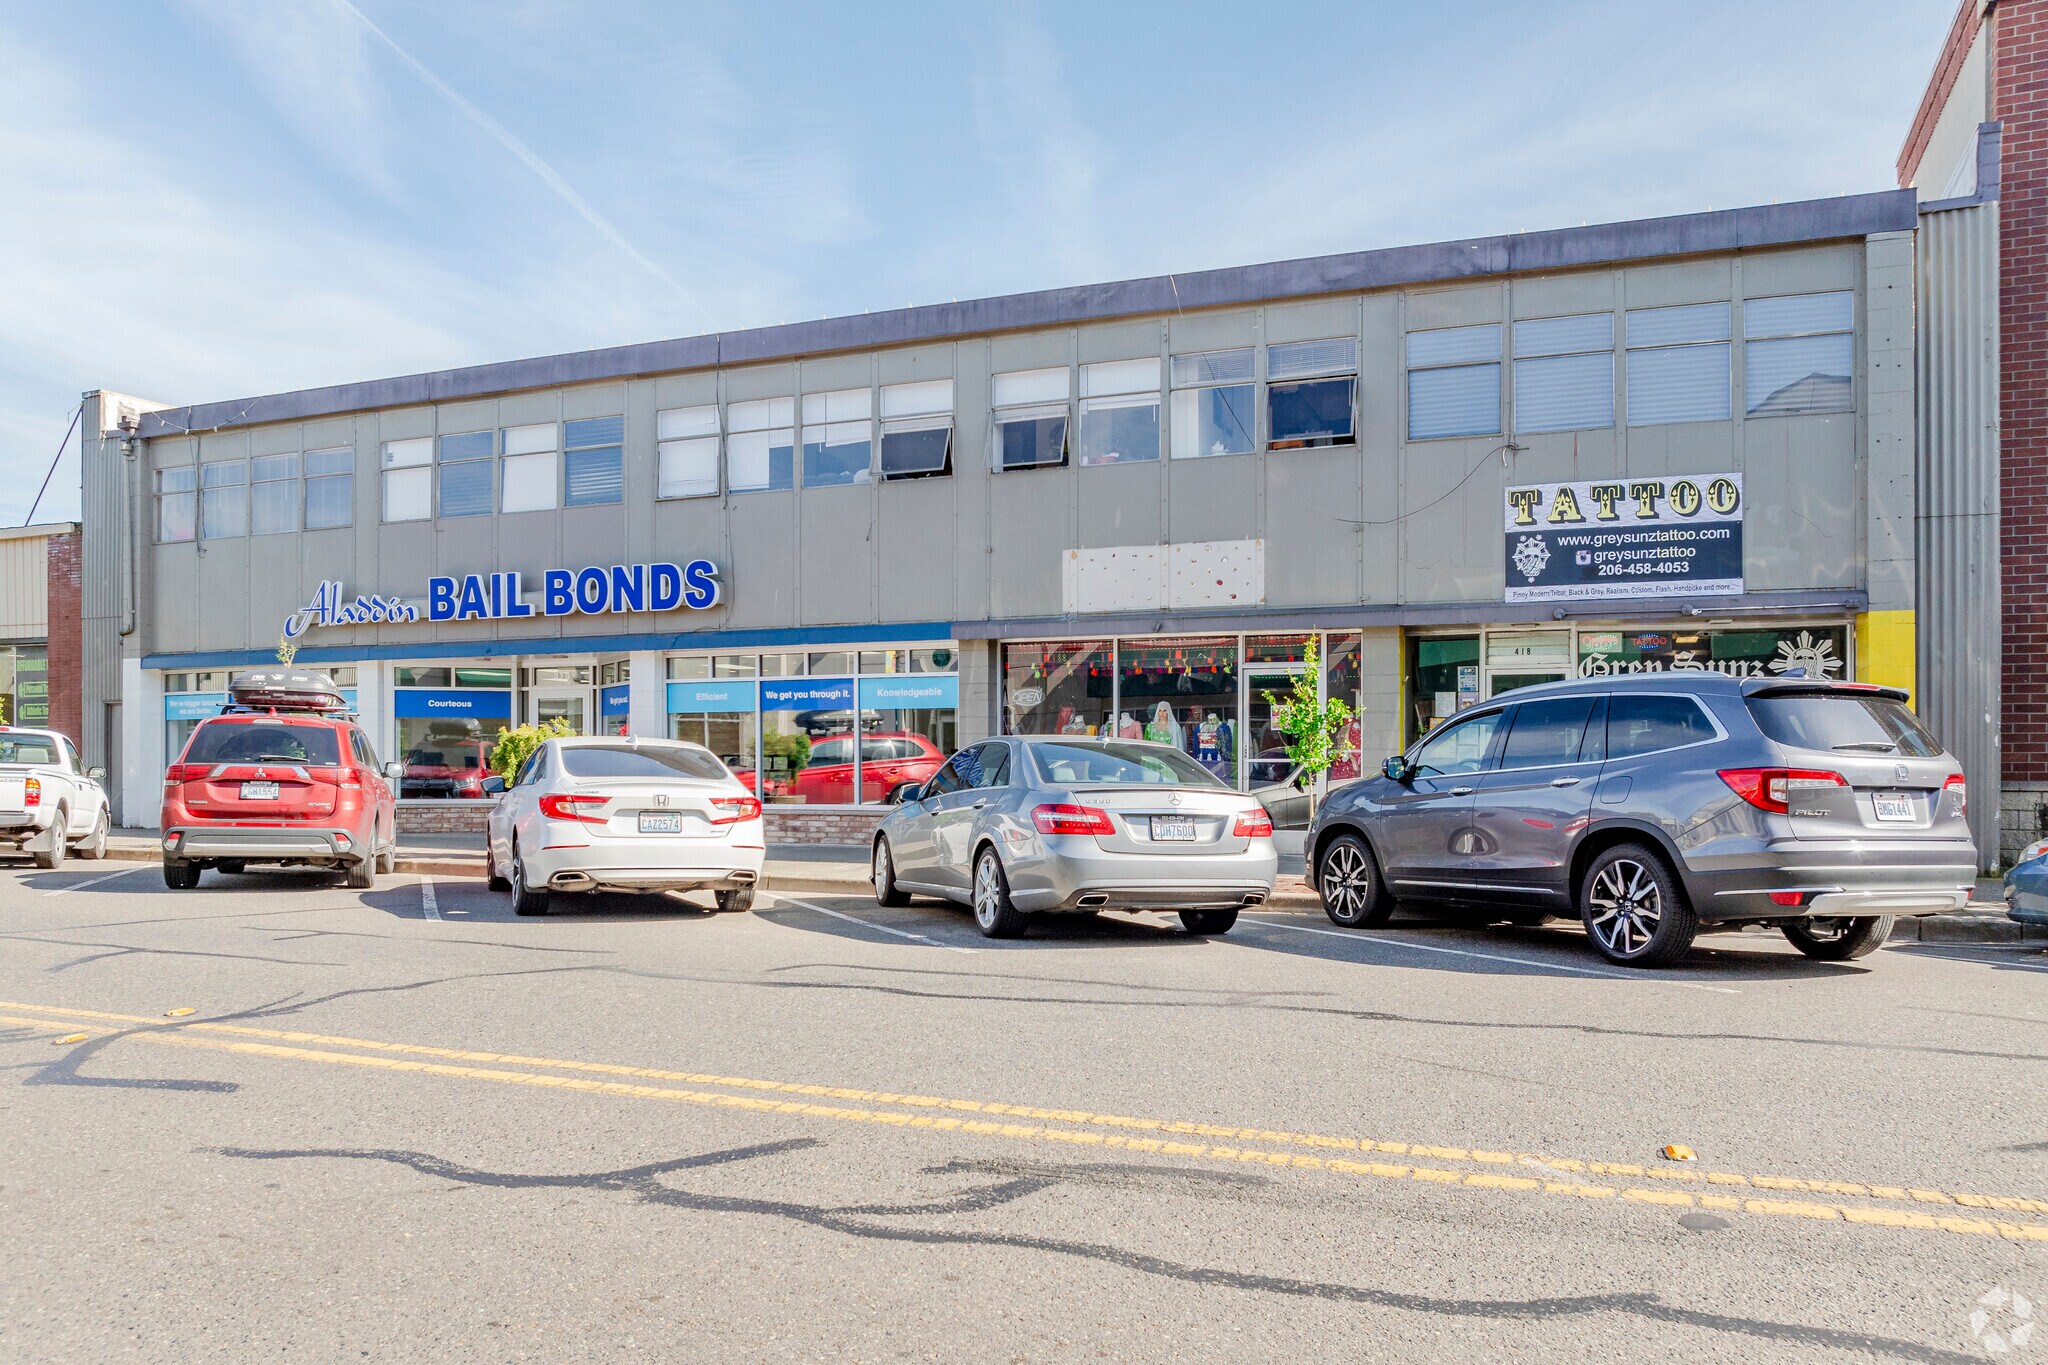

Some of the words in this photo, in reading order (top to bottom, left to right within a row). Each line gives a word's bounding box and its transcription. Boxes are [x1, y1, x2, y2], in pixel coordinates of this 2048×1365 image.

[1508, 477, 1740, 526] TATTOO
[1558, 527, 1730, 547] www.greysunztattoo.com
[1594, 546, 1696, 564] greysunztattoo
[1598, 561, 1690, 577] 206-458-4053
[284, 580, 419, 638] Aladdin
[428, 572, 536, 622] BAIL
[544, 559, 720, 617] BONDS
[1513, 591, 1529, 599] Pinoy
[1568, 588, 1584, 596] Black
[1631, 637, 1667, 647] TATTOO
[1514, 647, 1531, 655] 418
[696, 693, 728, 701] Efficient
[765, 691, 778, 699] We
[779, 692, 792, 701] get
[793, 692, 808, 701] you
[810, 690, 841, 700] through
[842, 690, 851, 698] it.
[877, 688, 942, 699] Knowledgeable
[1012, 691, 1043, 703] OPEN
[428, 699, 473, 708] Courteous
[641, 819, 679, 830] CAZ2574
[1154, 825, 1193, 837] CDH7600
